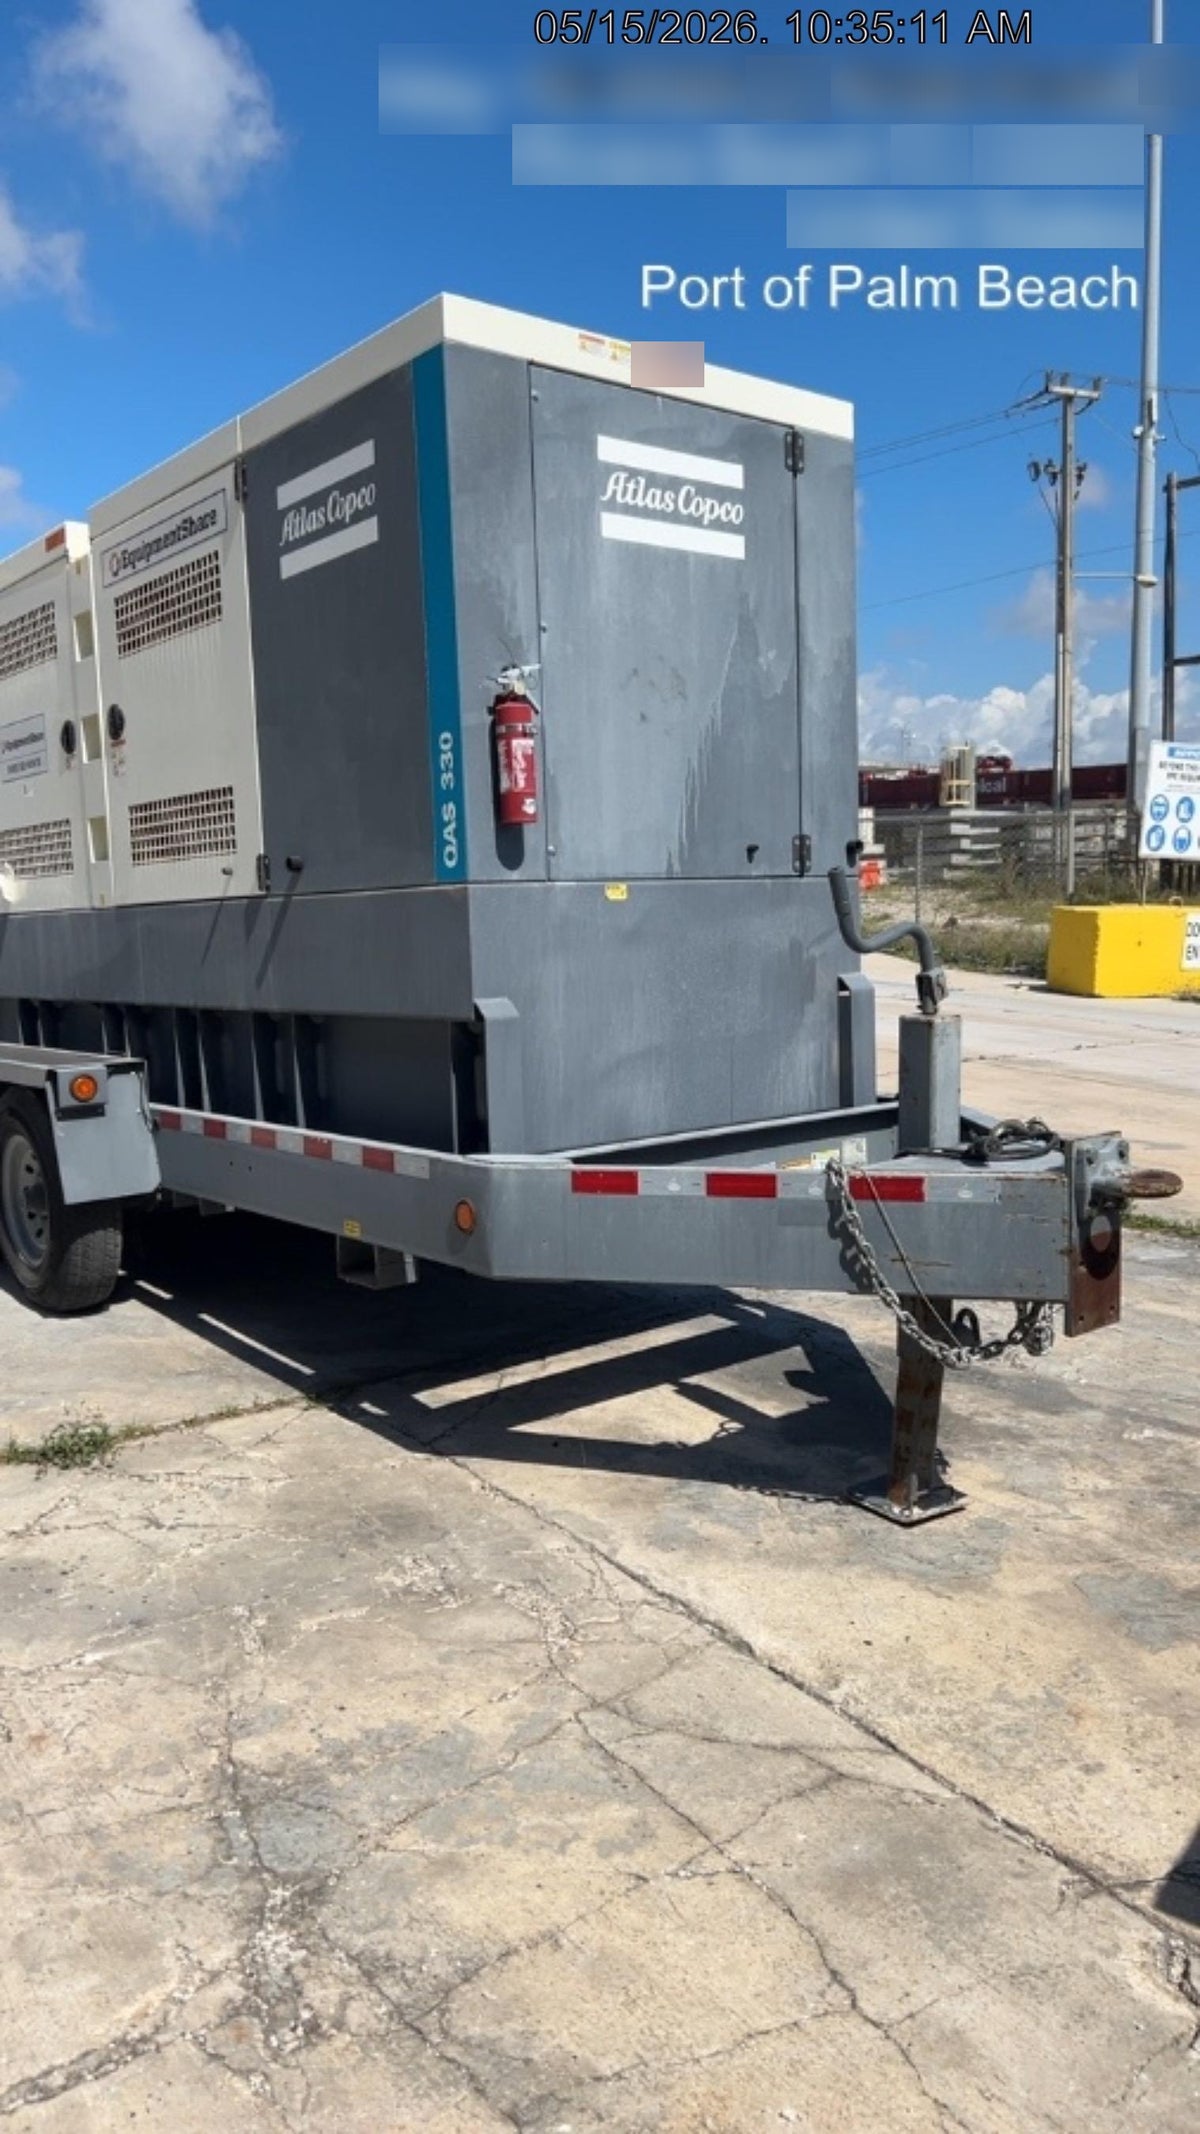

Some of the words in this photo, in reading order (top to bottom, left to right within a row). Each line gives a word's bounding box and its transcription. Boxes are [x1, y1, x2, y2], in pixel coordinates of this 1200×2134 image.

[280, 506, 326, 546] Atlas
[326, 483, 376, 524] Copco
[600, 470, 676, 513] Atlas
[677, 484, 744, 525] Copco
[121, 508, 216, 570] EquipmentShare
[438, 731, 455, 790] 330
